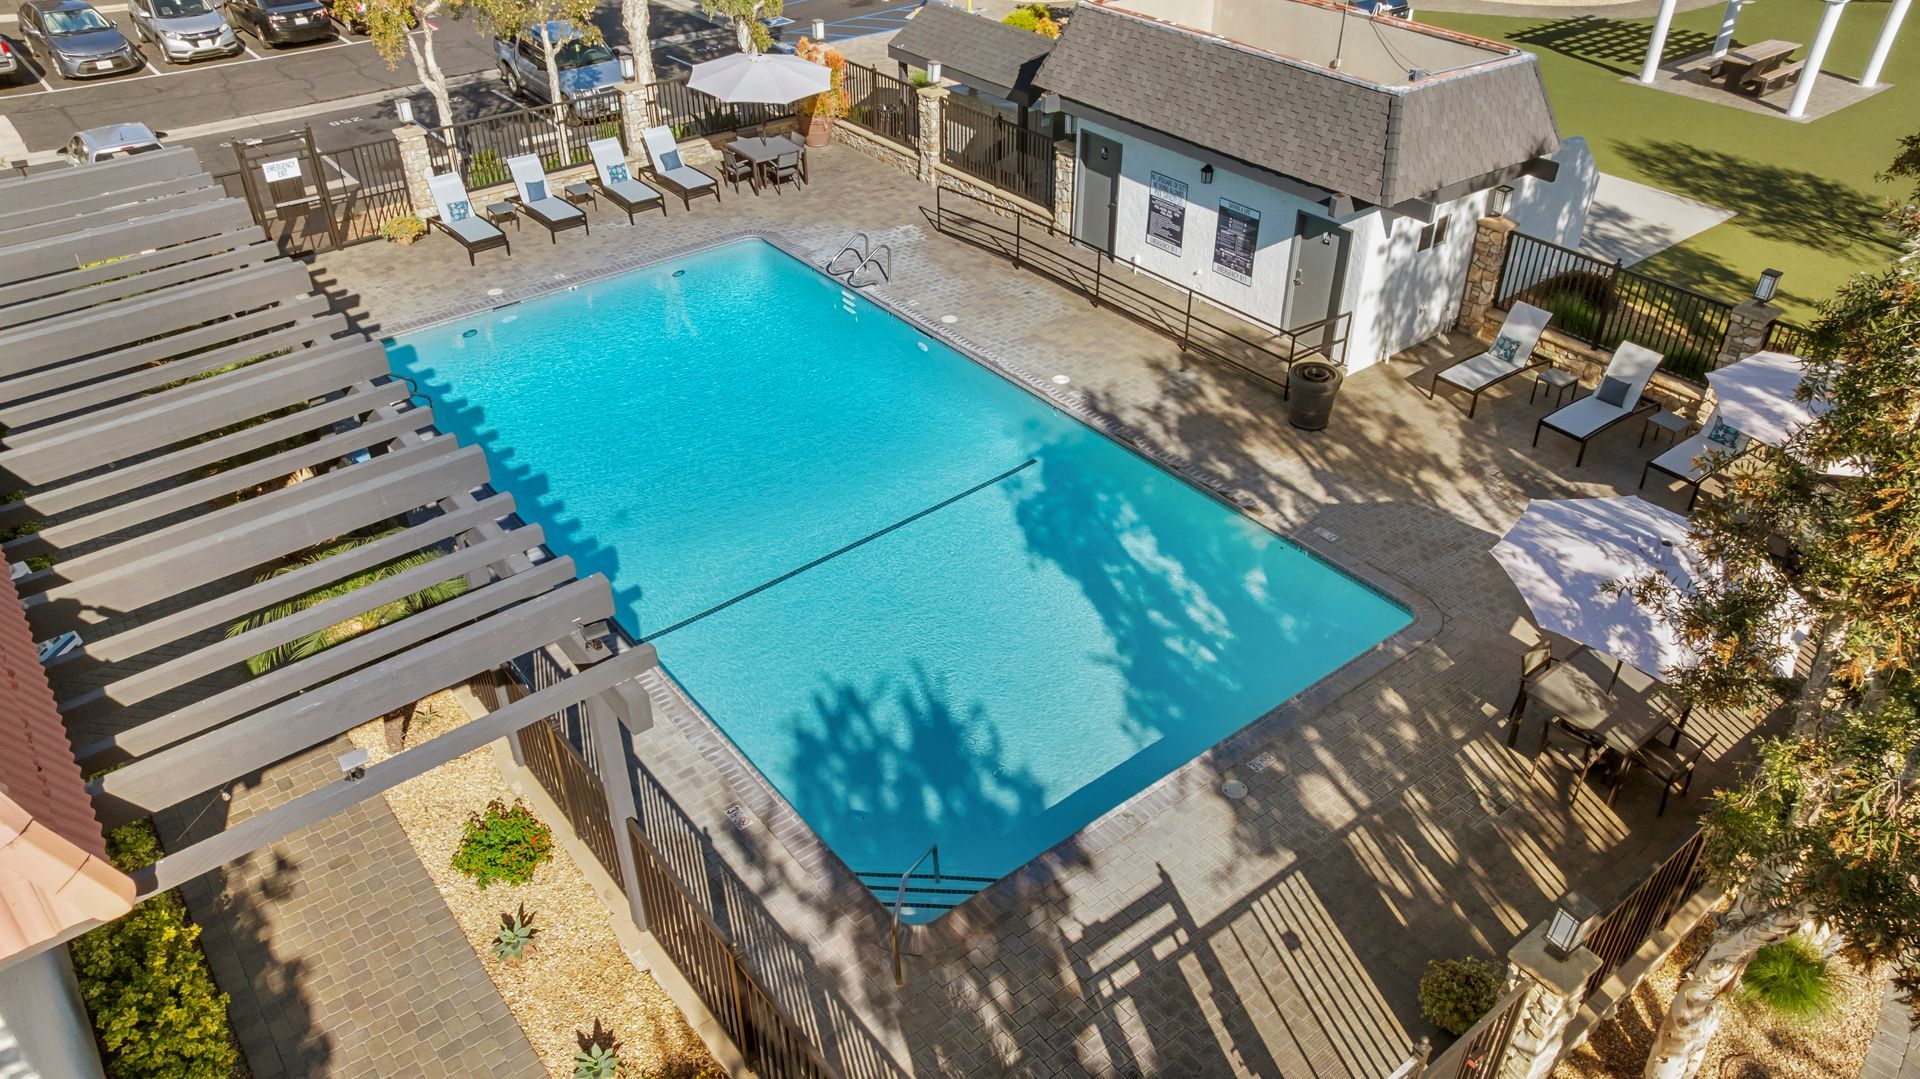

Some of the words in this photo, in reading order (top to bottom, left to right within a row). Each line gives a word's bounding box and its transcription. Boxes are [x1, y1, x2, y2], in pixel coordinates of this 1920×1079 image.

[266, 161, 295, 173] EMERGENCY
[277, 170, 288, 178] EXIT
[1151, 238, 1170, 250] EMERGENCY
[1217, 265, 1239, 279] EMERGENCY
[1239, 274, 1247, 283] 911
